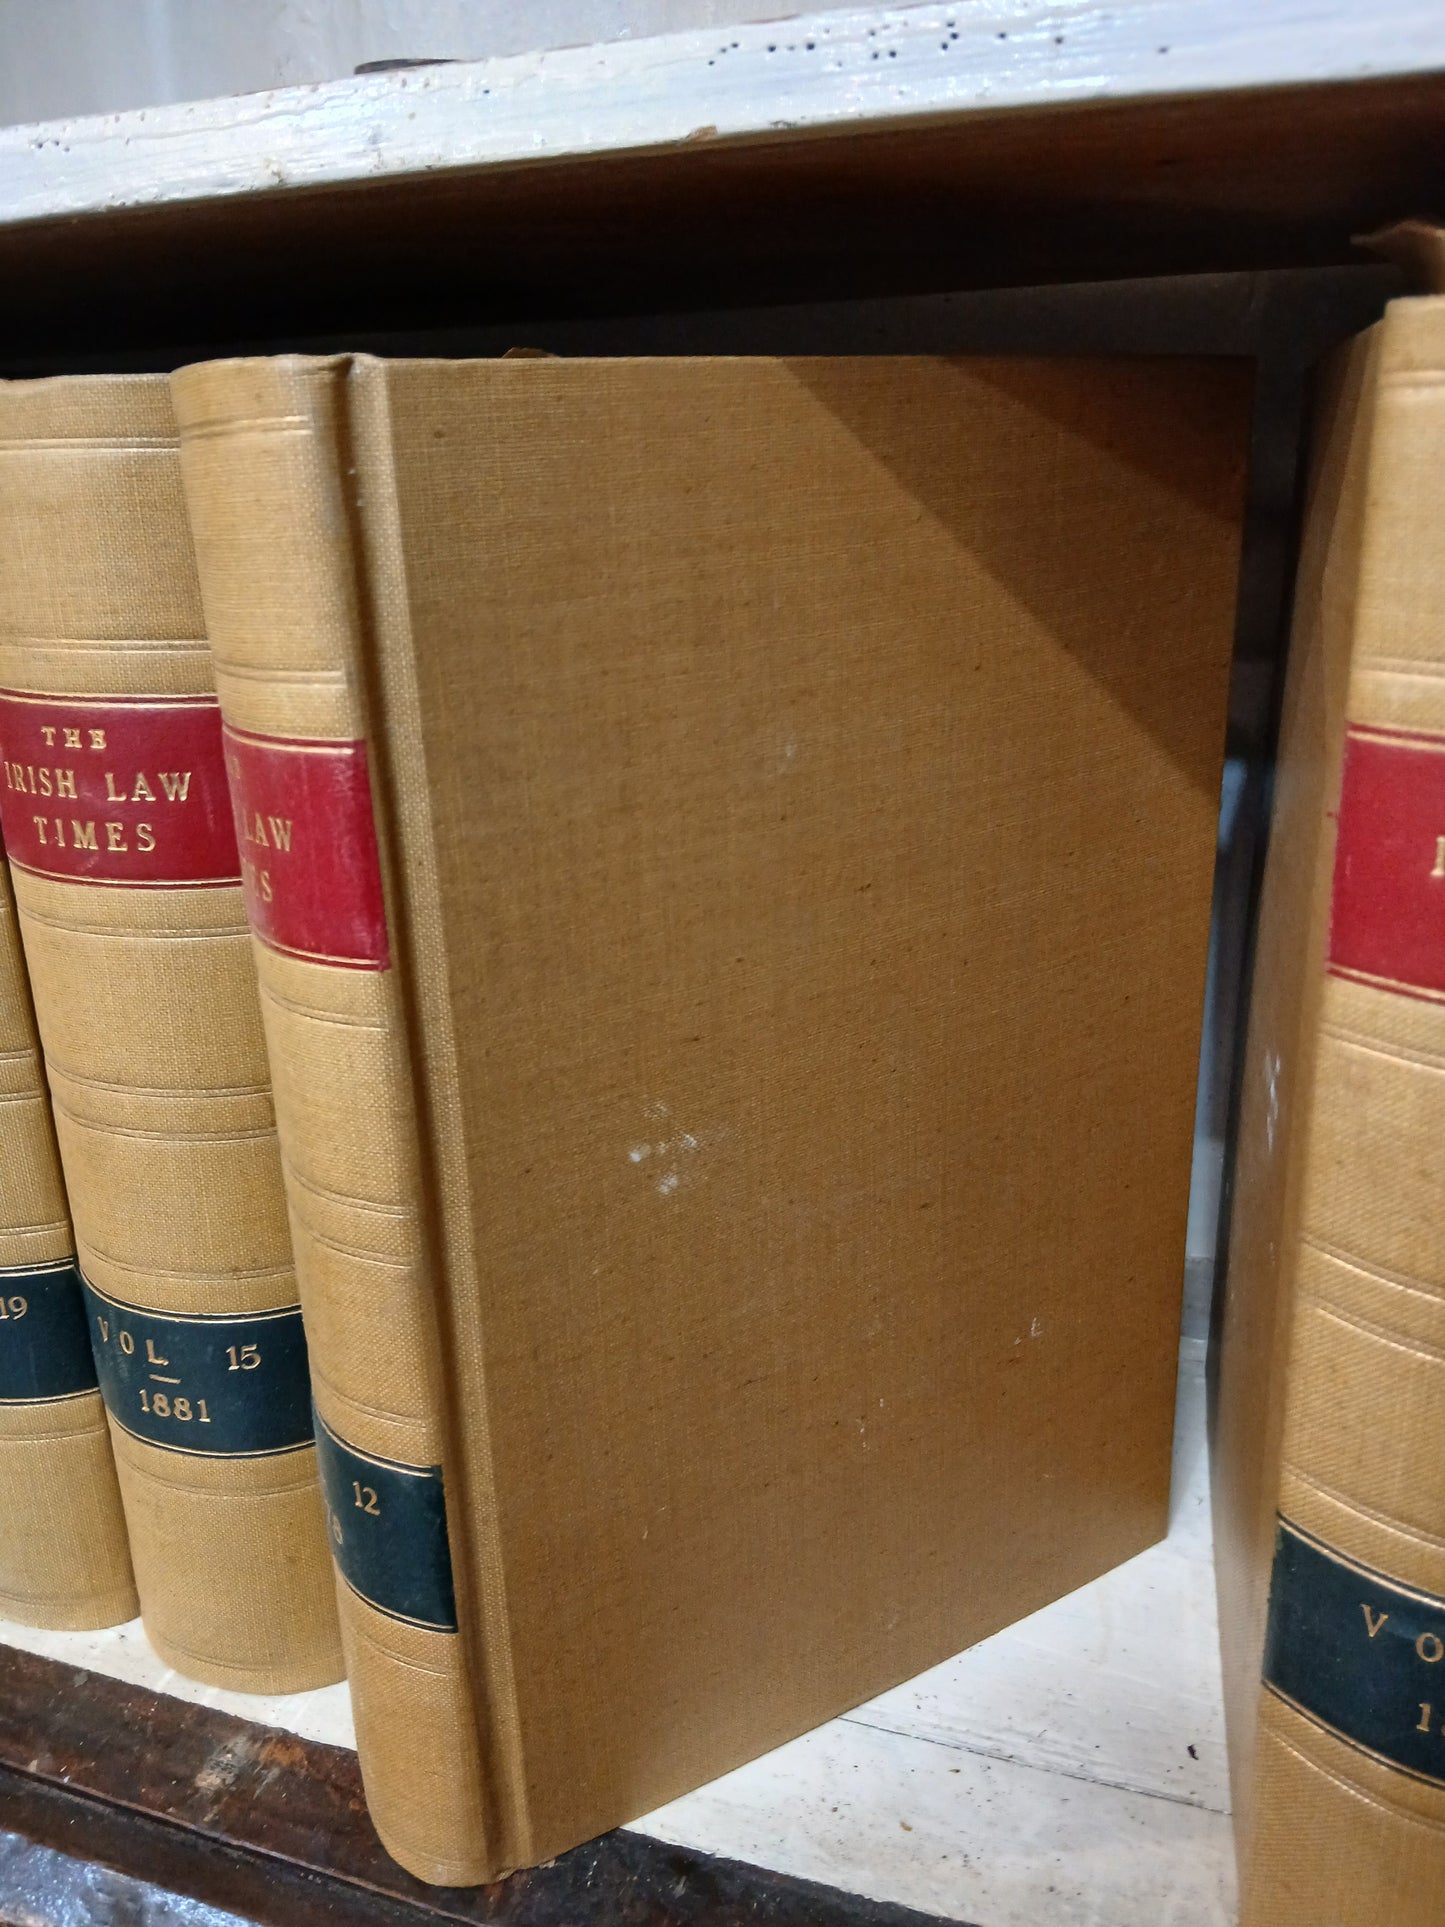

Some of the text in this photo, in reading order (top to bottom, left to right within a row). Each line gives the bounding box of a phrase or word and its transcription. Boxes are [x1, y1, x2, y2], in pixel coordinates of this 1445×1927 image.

[41, 726, 107, 749] THE
[4, 761, 192, 802] IRISH LAW
[33, 815, 156, 852] TIMES
[0, 1296, 28, 1320] 19
[97, 1316, 262, 1371] VOL 15
[139, 1389, 212, 1423] 1881
[352, 1481, 380, 1516] 12
